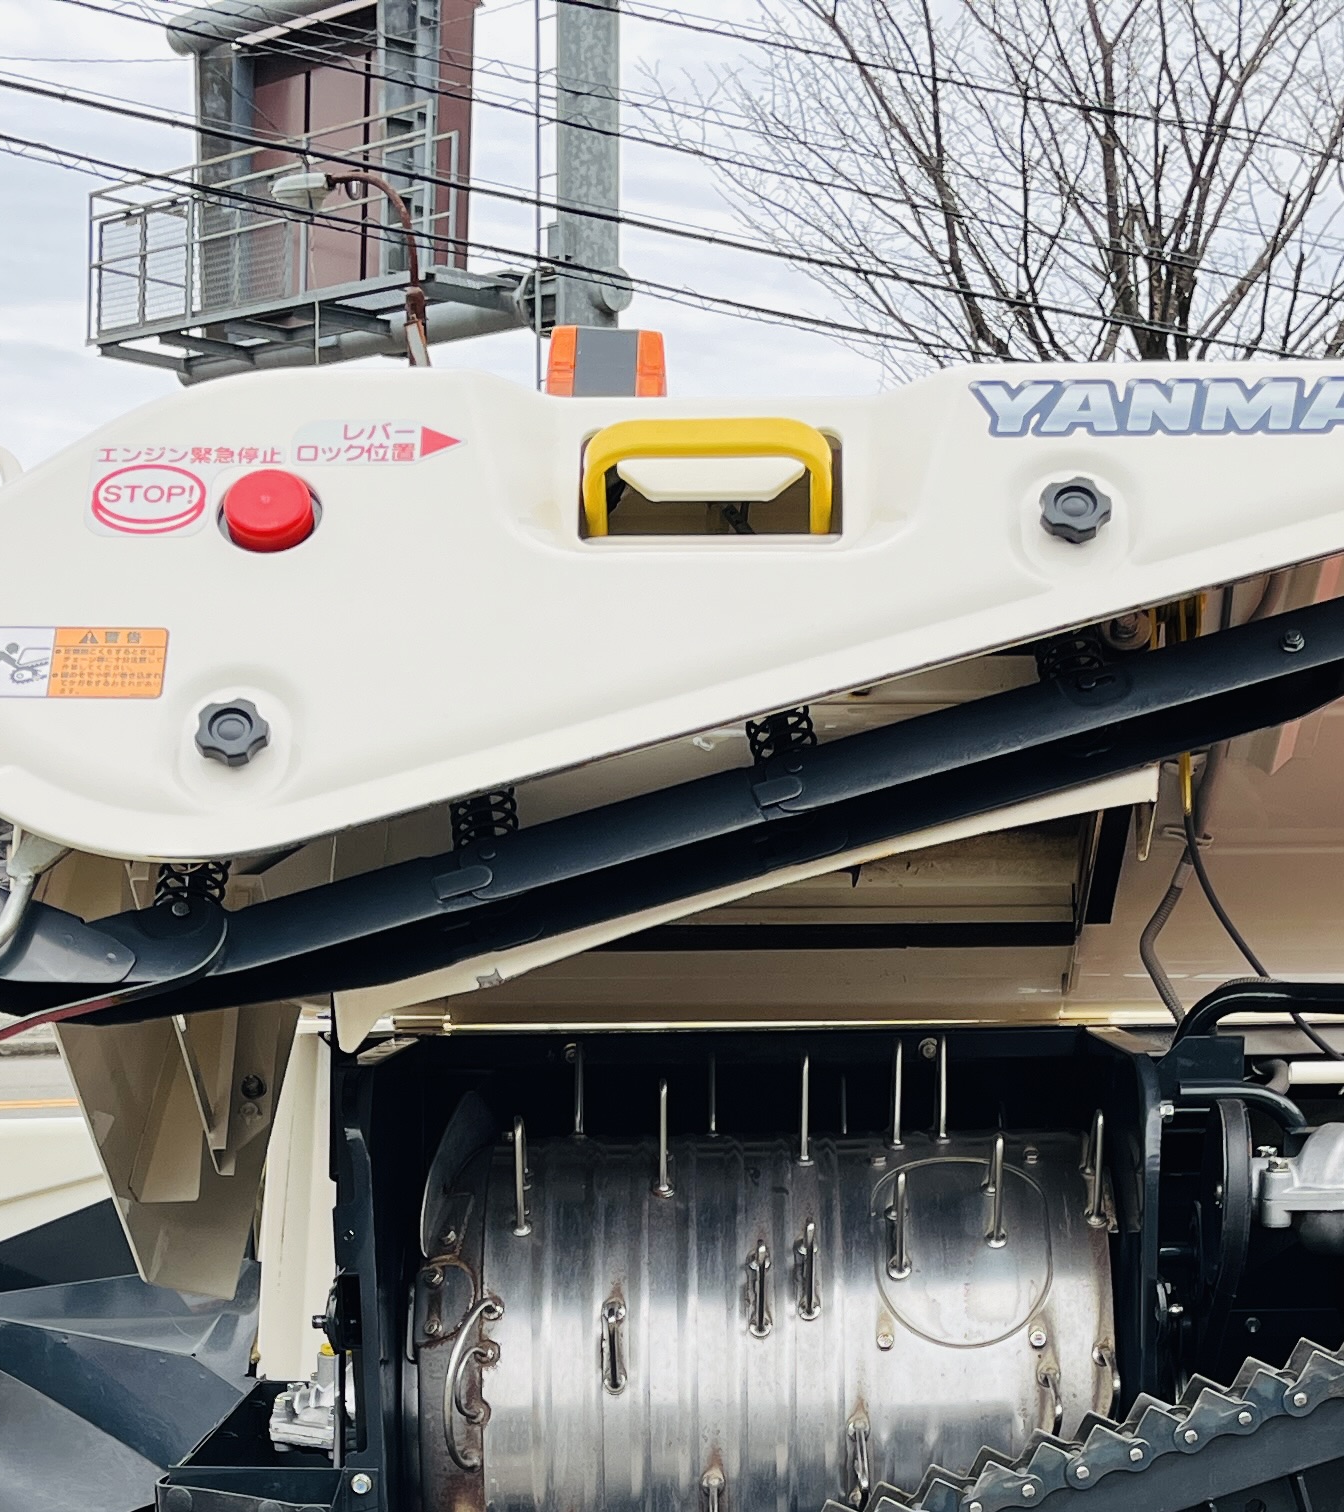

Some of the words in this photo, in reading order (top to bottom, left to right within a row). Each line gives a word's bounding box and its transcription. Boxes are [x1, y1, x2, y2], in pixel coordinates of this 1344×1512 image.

[344, 423, 415, 441] レバー
[97, 447, 282, 464] エンジン緊急停止
[296, 443, 416, 462] ロック位置
[103, 485, 195, 504] STOP!
